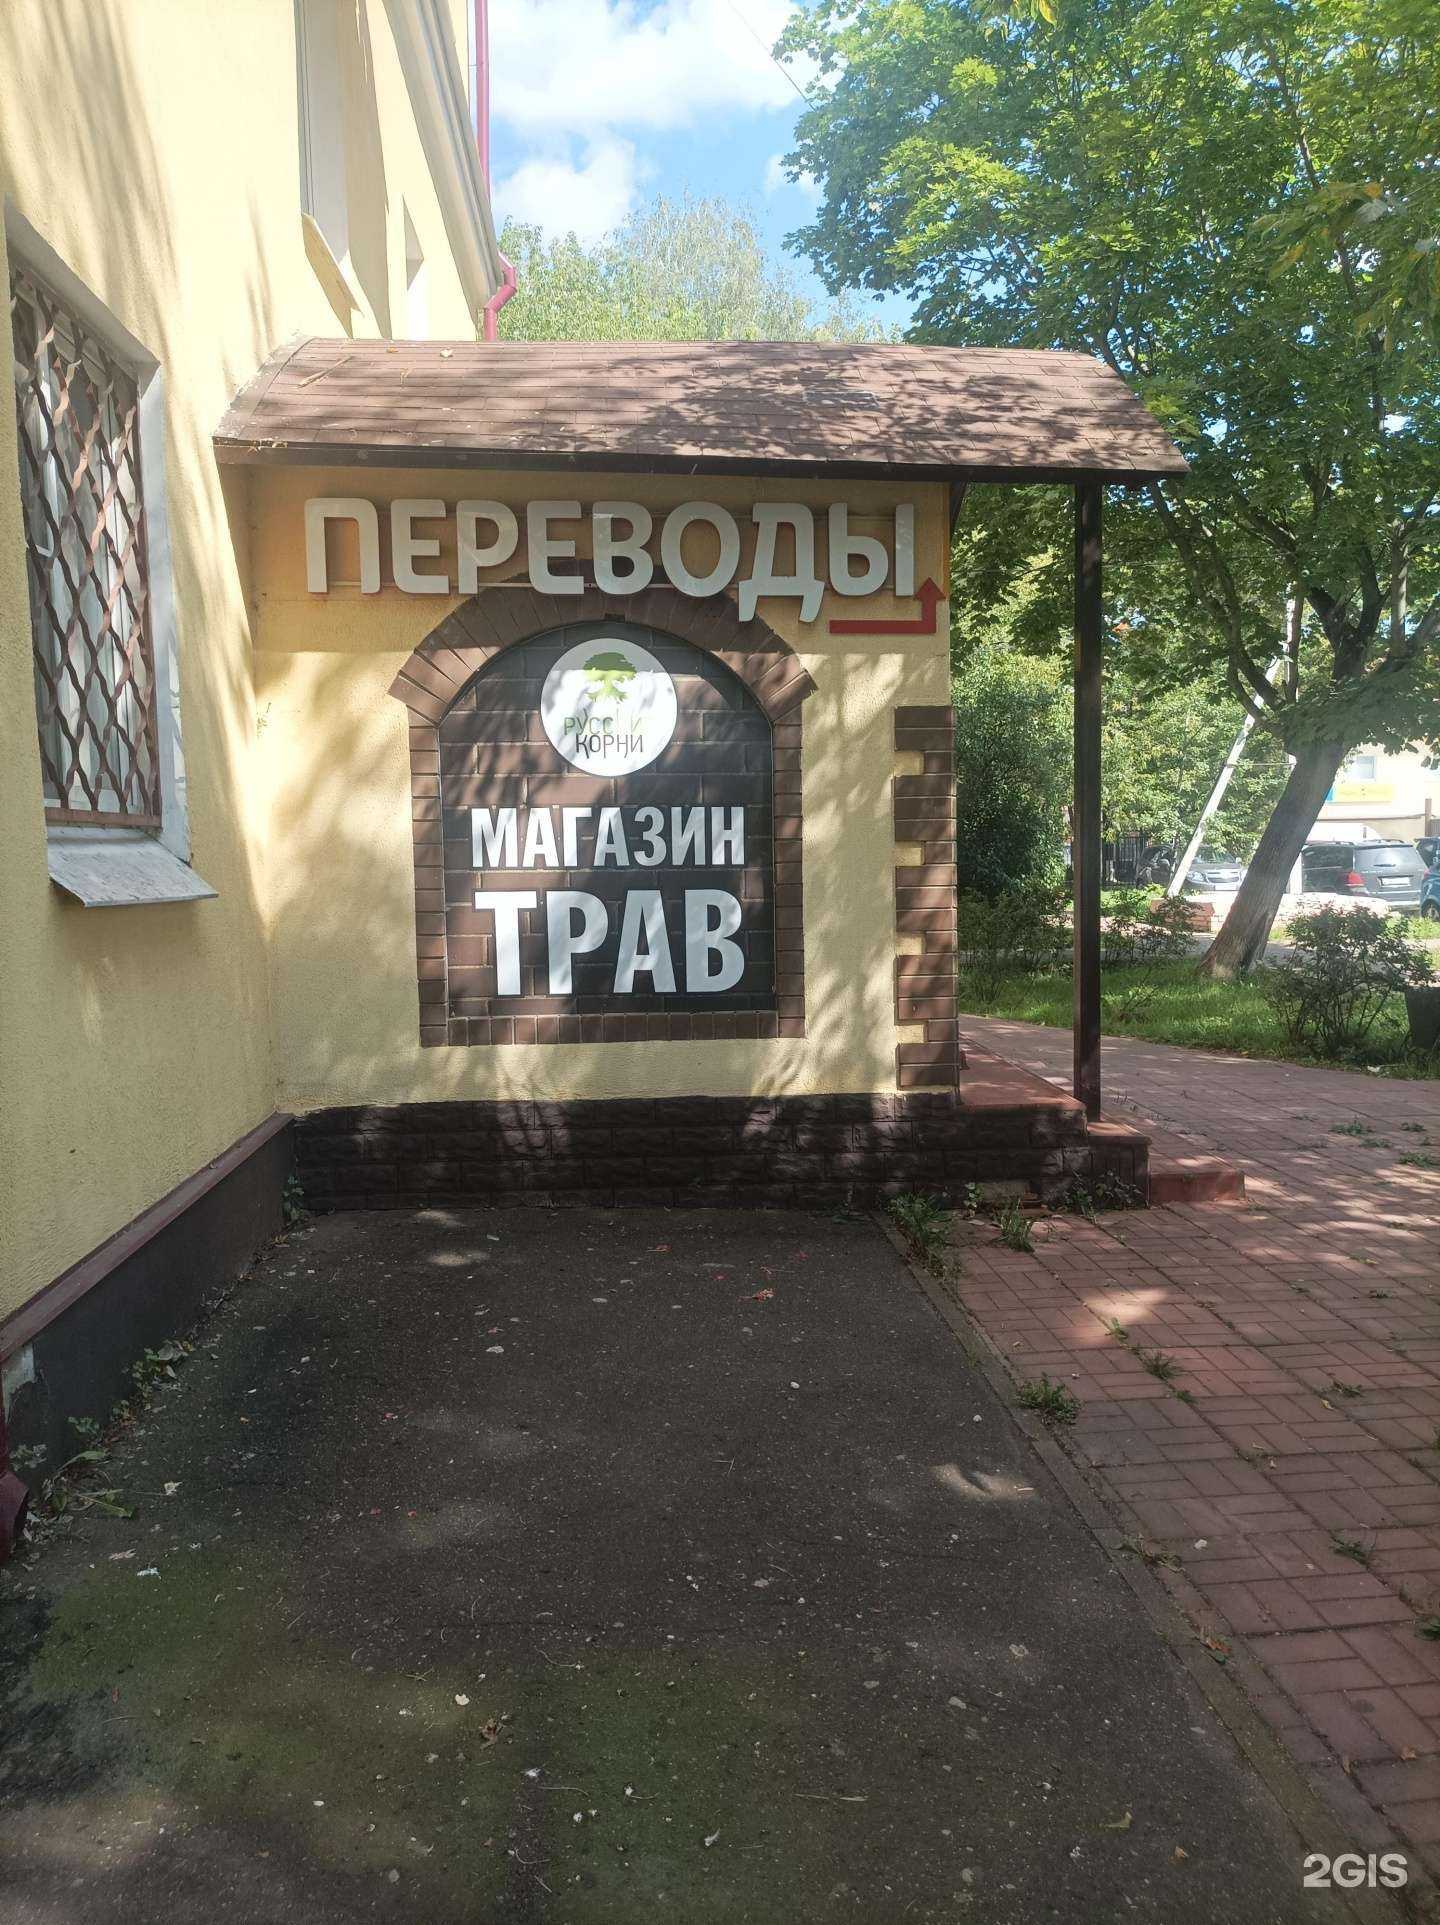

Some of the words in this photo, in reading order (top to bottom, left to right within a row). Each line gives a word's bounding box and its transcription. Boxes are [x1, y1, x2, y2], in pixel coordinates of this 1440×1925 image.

[304, 497, 915, 623] ПЕРЕВОДЫ
[575, 734, 644, 759] КОРНИ
[470, 806, 745, 868] МАГАЗИН
[474, 888, 746, 996] ТРАВ
